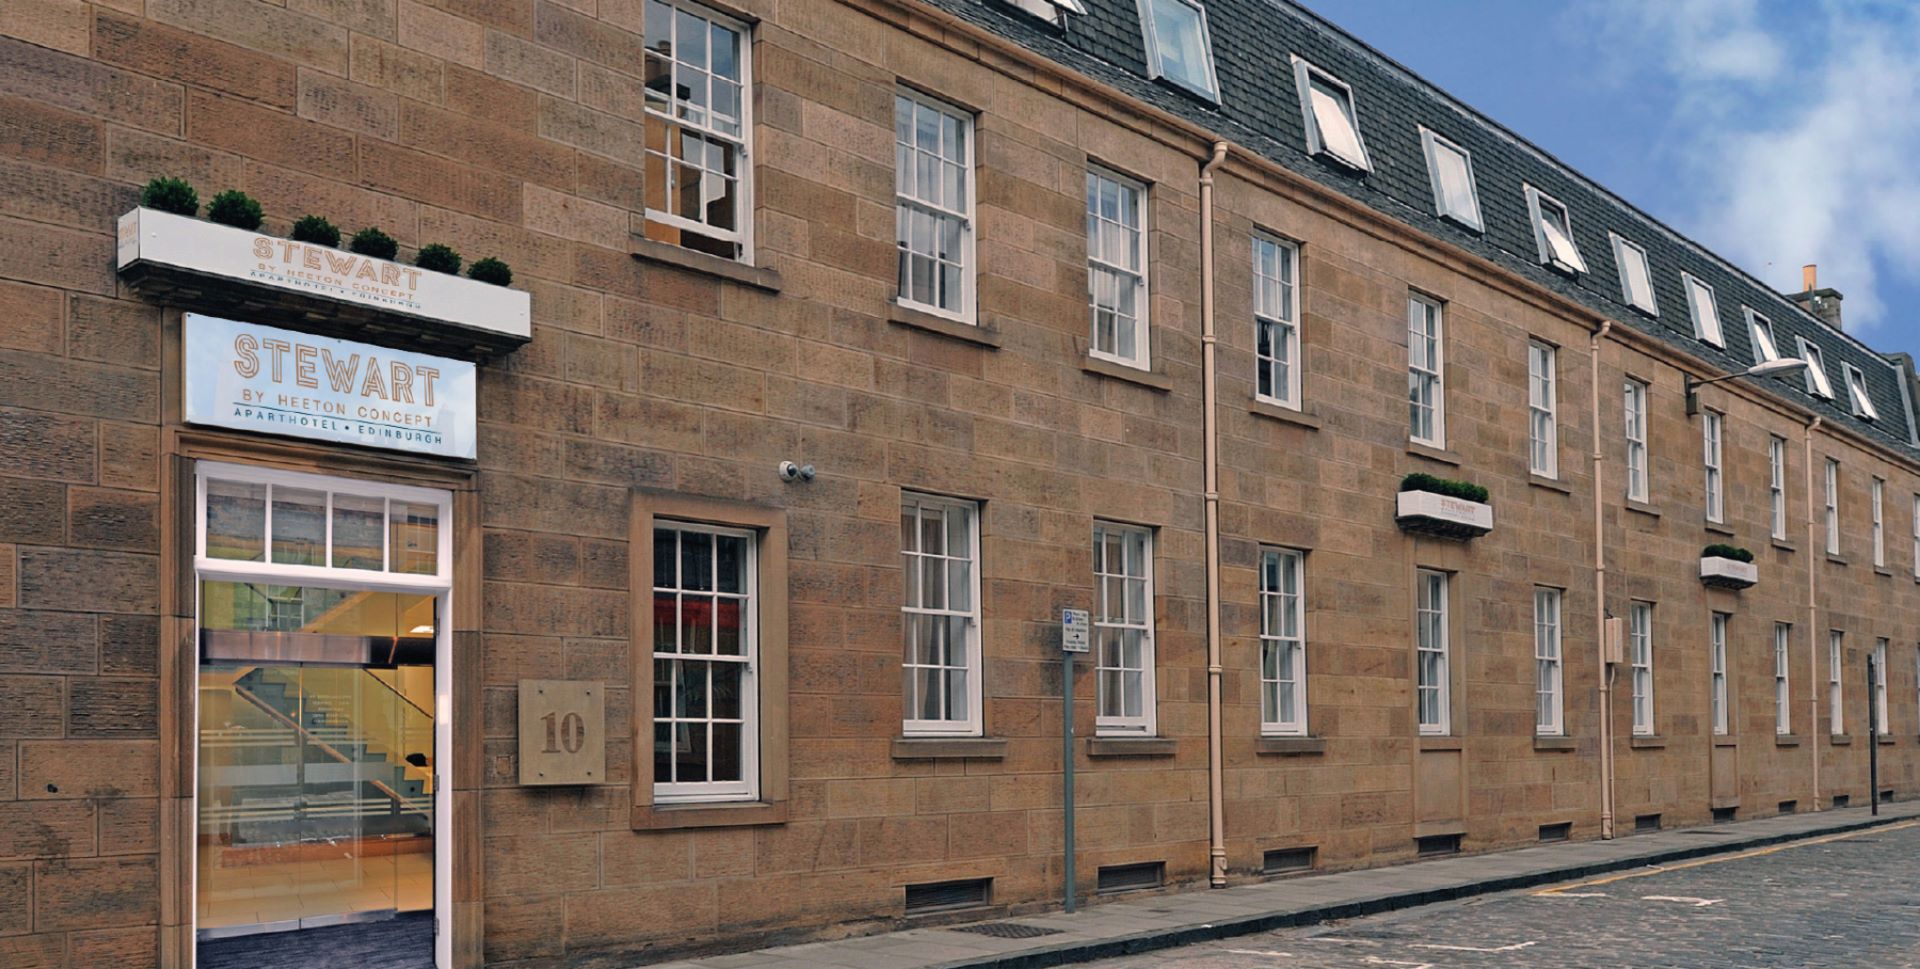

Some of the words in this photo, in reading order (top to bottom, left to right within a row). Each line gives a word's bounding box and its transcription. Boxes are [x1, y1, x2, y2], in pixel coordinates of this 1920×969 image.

[252, 237, 422, 290] STEWART
[258, 263, 277, 272] BY
[287, 269, 343, 286] HEETON
[352, 282, 413, 300] CONCEPT
[233, 333, 440, 407] STEWART
[234, 408, 338, 431] APARTHOTEL
[358, 425, 442, 445] EDINBURGH
[243, 389, 264, 403] BY
[278, 393, 345, 415] HEETON
[358, 406, 432, 427] CONCEPT
[540, 712, 585, 754] 10
